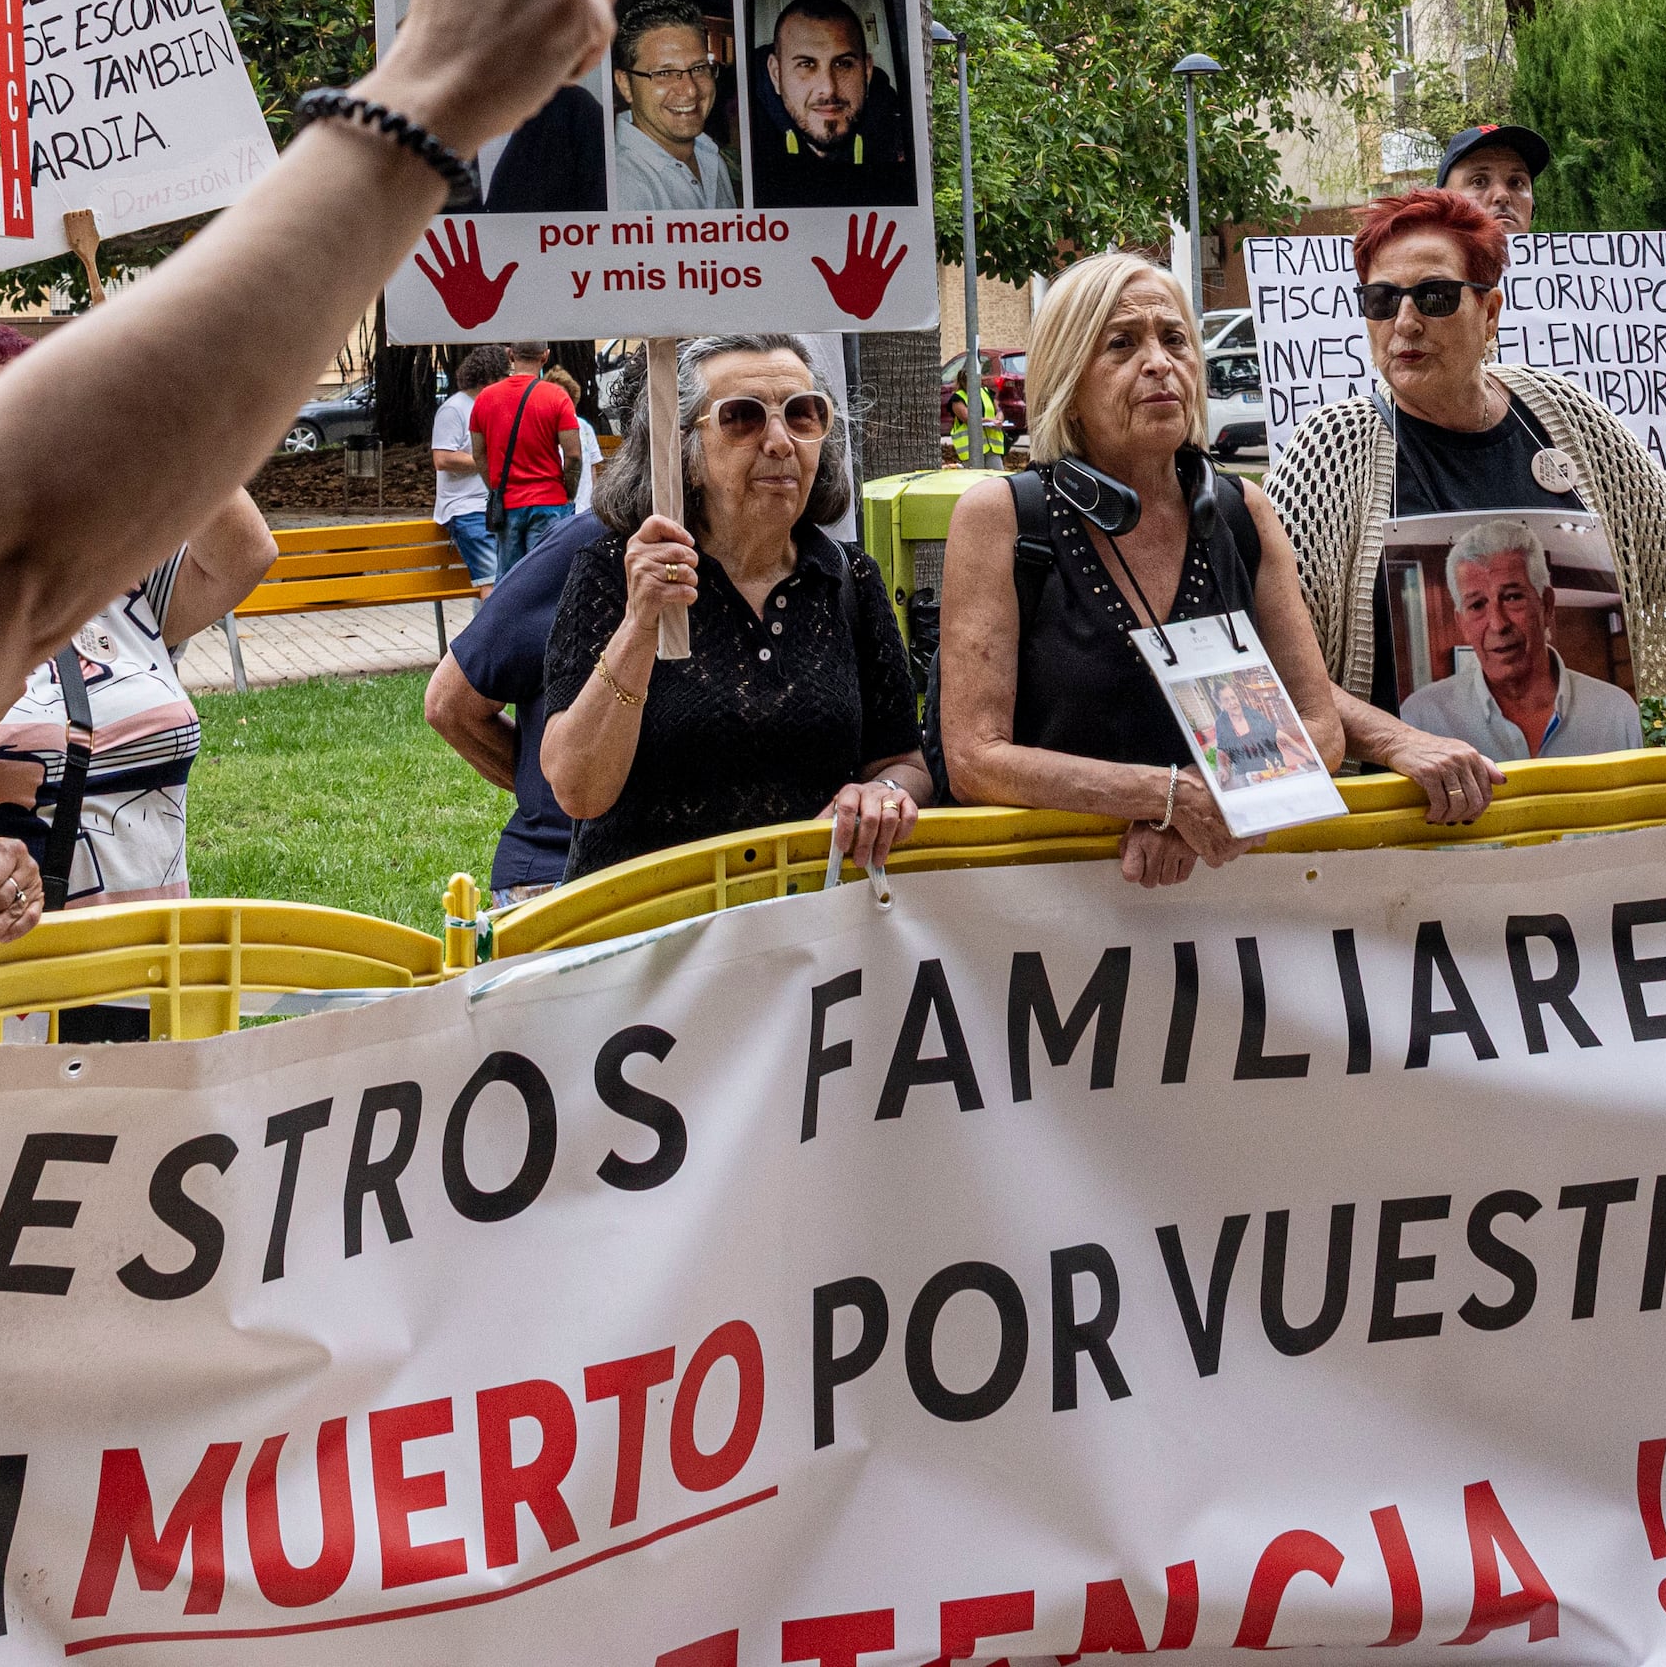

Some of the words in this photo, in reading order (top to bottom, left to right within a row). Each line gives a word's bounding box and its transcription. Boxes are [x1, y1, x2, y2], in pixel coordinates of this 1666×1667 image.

[83, 20, 234, 100] TAMBIEN
[31, 111, 171, 187] ARDIA.
[539, 219, 600, 254] por
[613, 216, 655, 245] mi
[667, 213, 790, 244] marido
[571, 269, 590, 298] y
[602, 262, 666, 291] mis
[677, 260, 763, 297] hijos
[1248, 237, 1356, 276] FRAUD
[1258, 284, 1364, 323] FISCA
[1263, 334, 1366, 383] INVES
[70, 1319, 765, 1622] MUERTO
[813, 1241, 1133, 1451] POR
